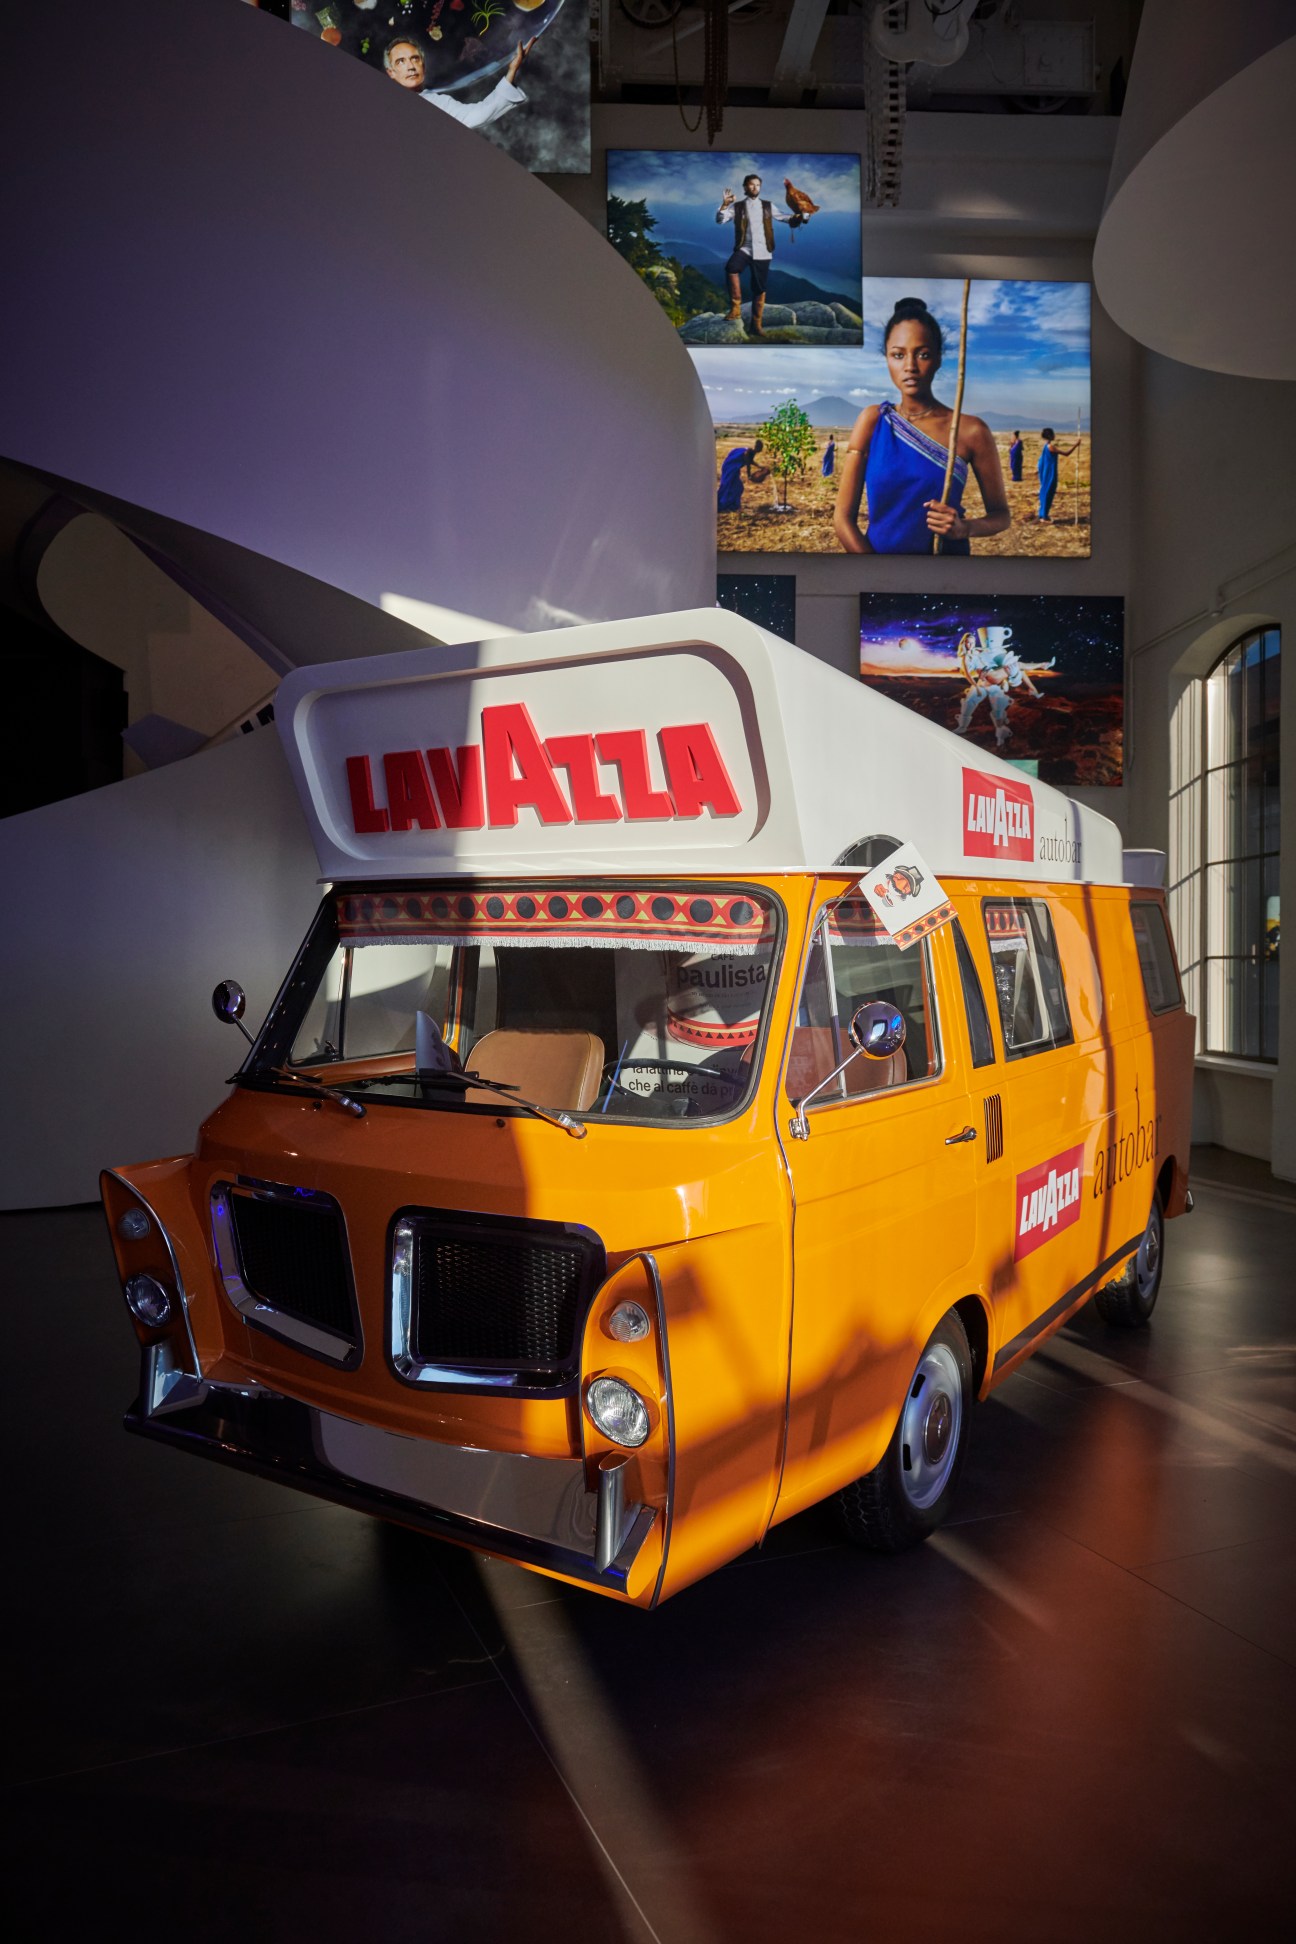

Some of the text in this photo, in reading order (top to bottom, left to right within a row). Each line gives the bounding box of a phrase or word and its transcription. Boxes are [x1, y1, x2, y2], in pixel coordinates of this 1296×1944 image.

[346, 702, 742, 833] LAVAZZA
[967, 788, 1081, 863] LAVAZZA autobar
[677, 963, 766, 988] paulista
[628, 1079, 651, 1092] che
[654, 1080, 664, 1092] al
[667, 1081, 698, 1094] caffè
[1019, 1072, 1162, 1236] LAVAZZA autobar
